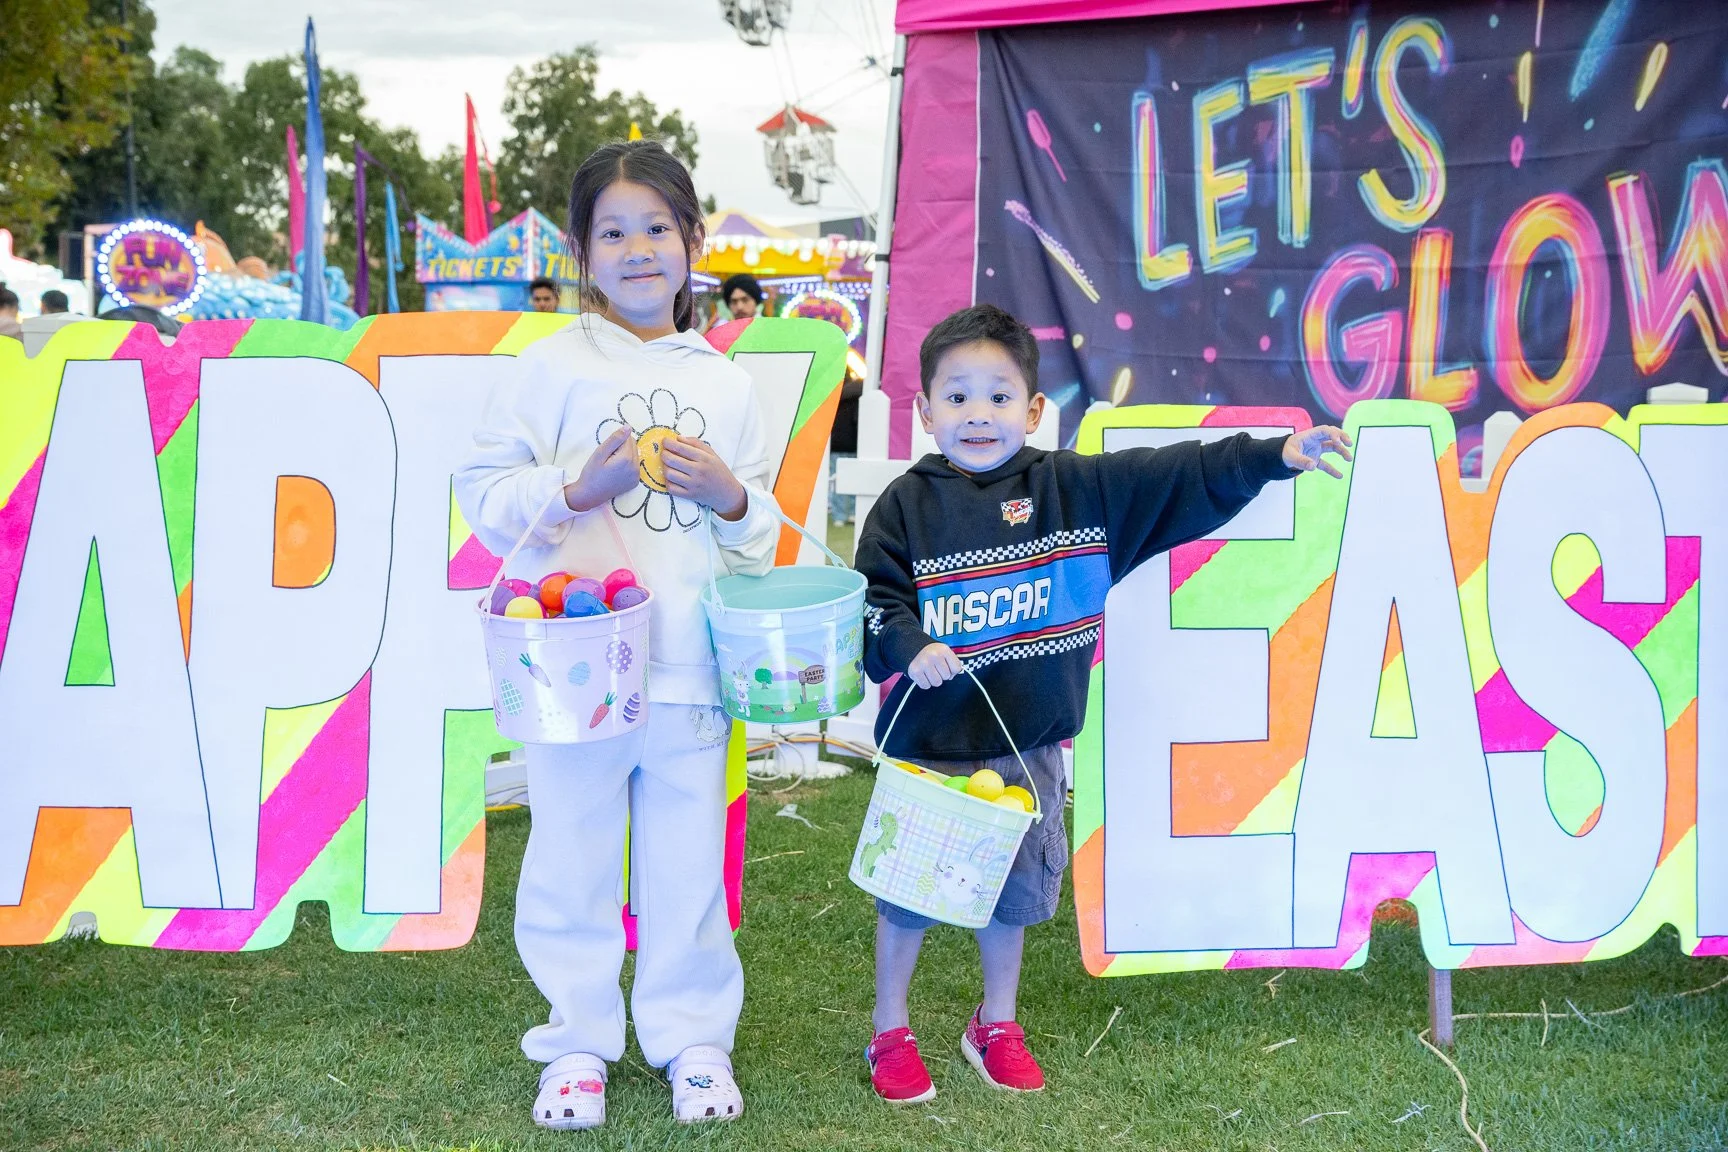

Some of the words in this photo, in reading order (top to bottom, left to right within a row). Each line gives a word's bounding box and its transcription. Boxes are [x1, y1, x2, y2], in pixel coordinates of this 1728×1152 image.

[1132, 17, 1452, 290] LET'S
[123, 234, 182, 270] FUN
[427, 256, 522, 278] TICKETS
[115, 264, 189, 296] ZONE
[1303, 157, 1728, 418] GLOW
[922, 577, 1052, 638] NASCAR
